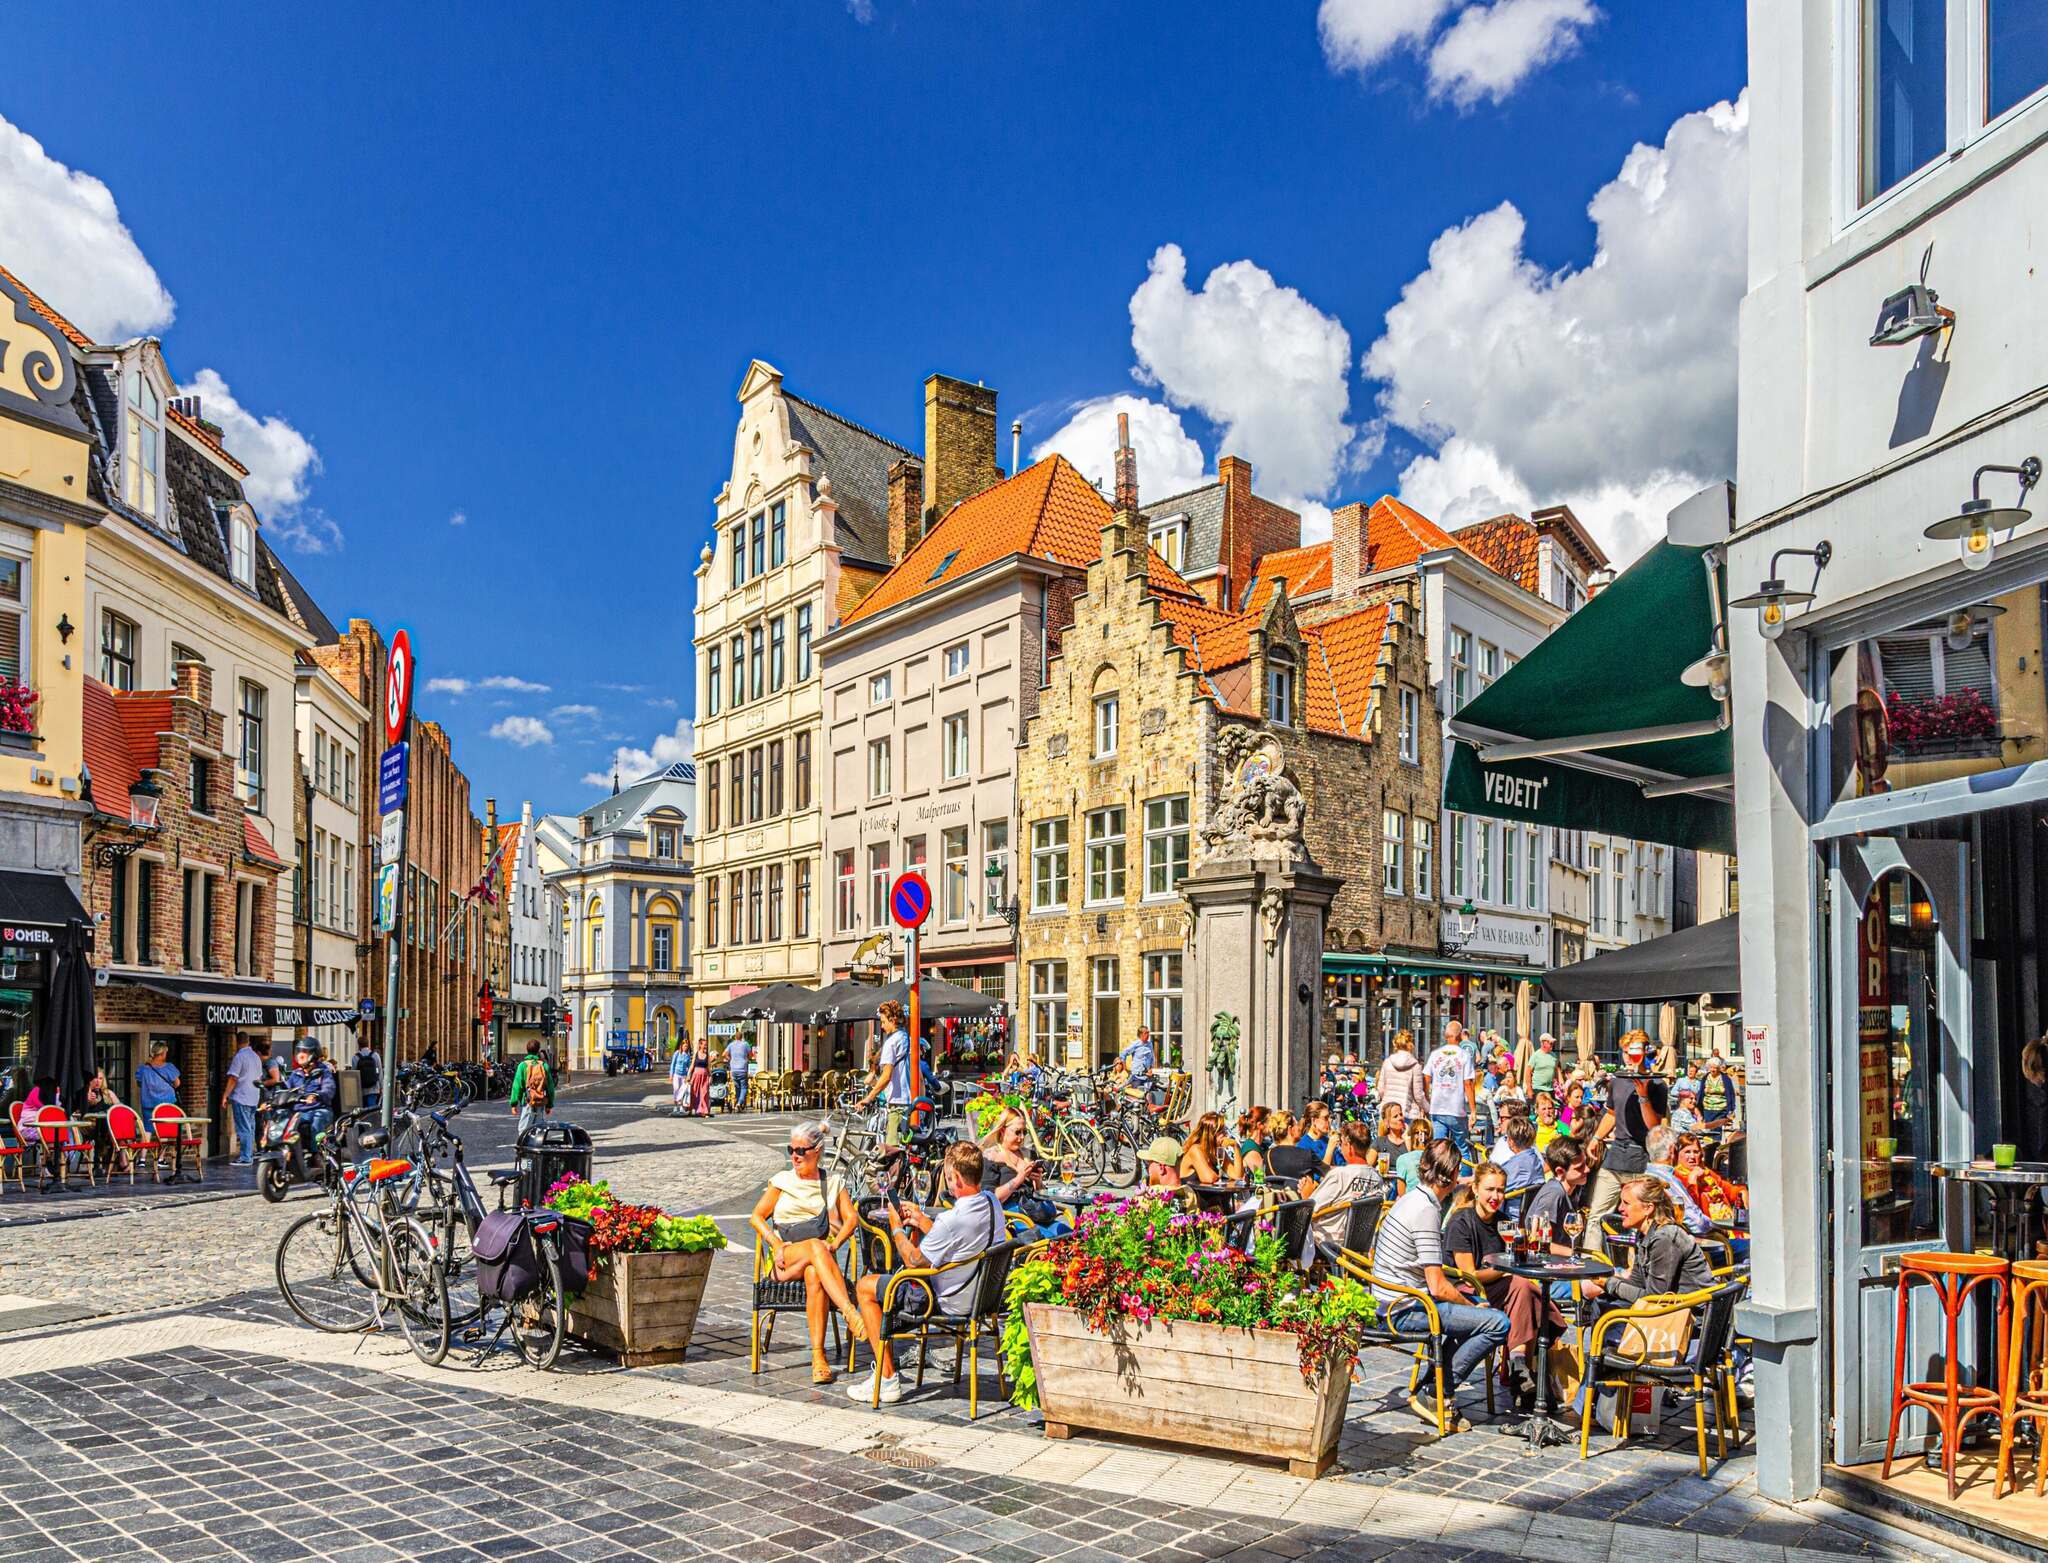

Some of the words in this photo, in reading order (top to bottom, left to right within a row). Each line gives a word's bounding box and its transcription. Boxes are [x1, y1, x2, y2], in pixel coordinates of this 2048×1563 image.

[1484, 771, 1542, 810] VEDETT
[915, 801, 961, 823] Malpertuus
[1481, 926, 1496, 942] VAN
[1497, 928, 1545, 947] REMBRANDT
[207, 1004, 264, 1025] CHOCOLATIER
[276, 1008, 302, 1026] DUMON
[1746, 1030, 1765, 1041] Duvel
[1752, 1048, 1761, 1065] 19
